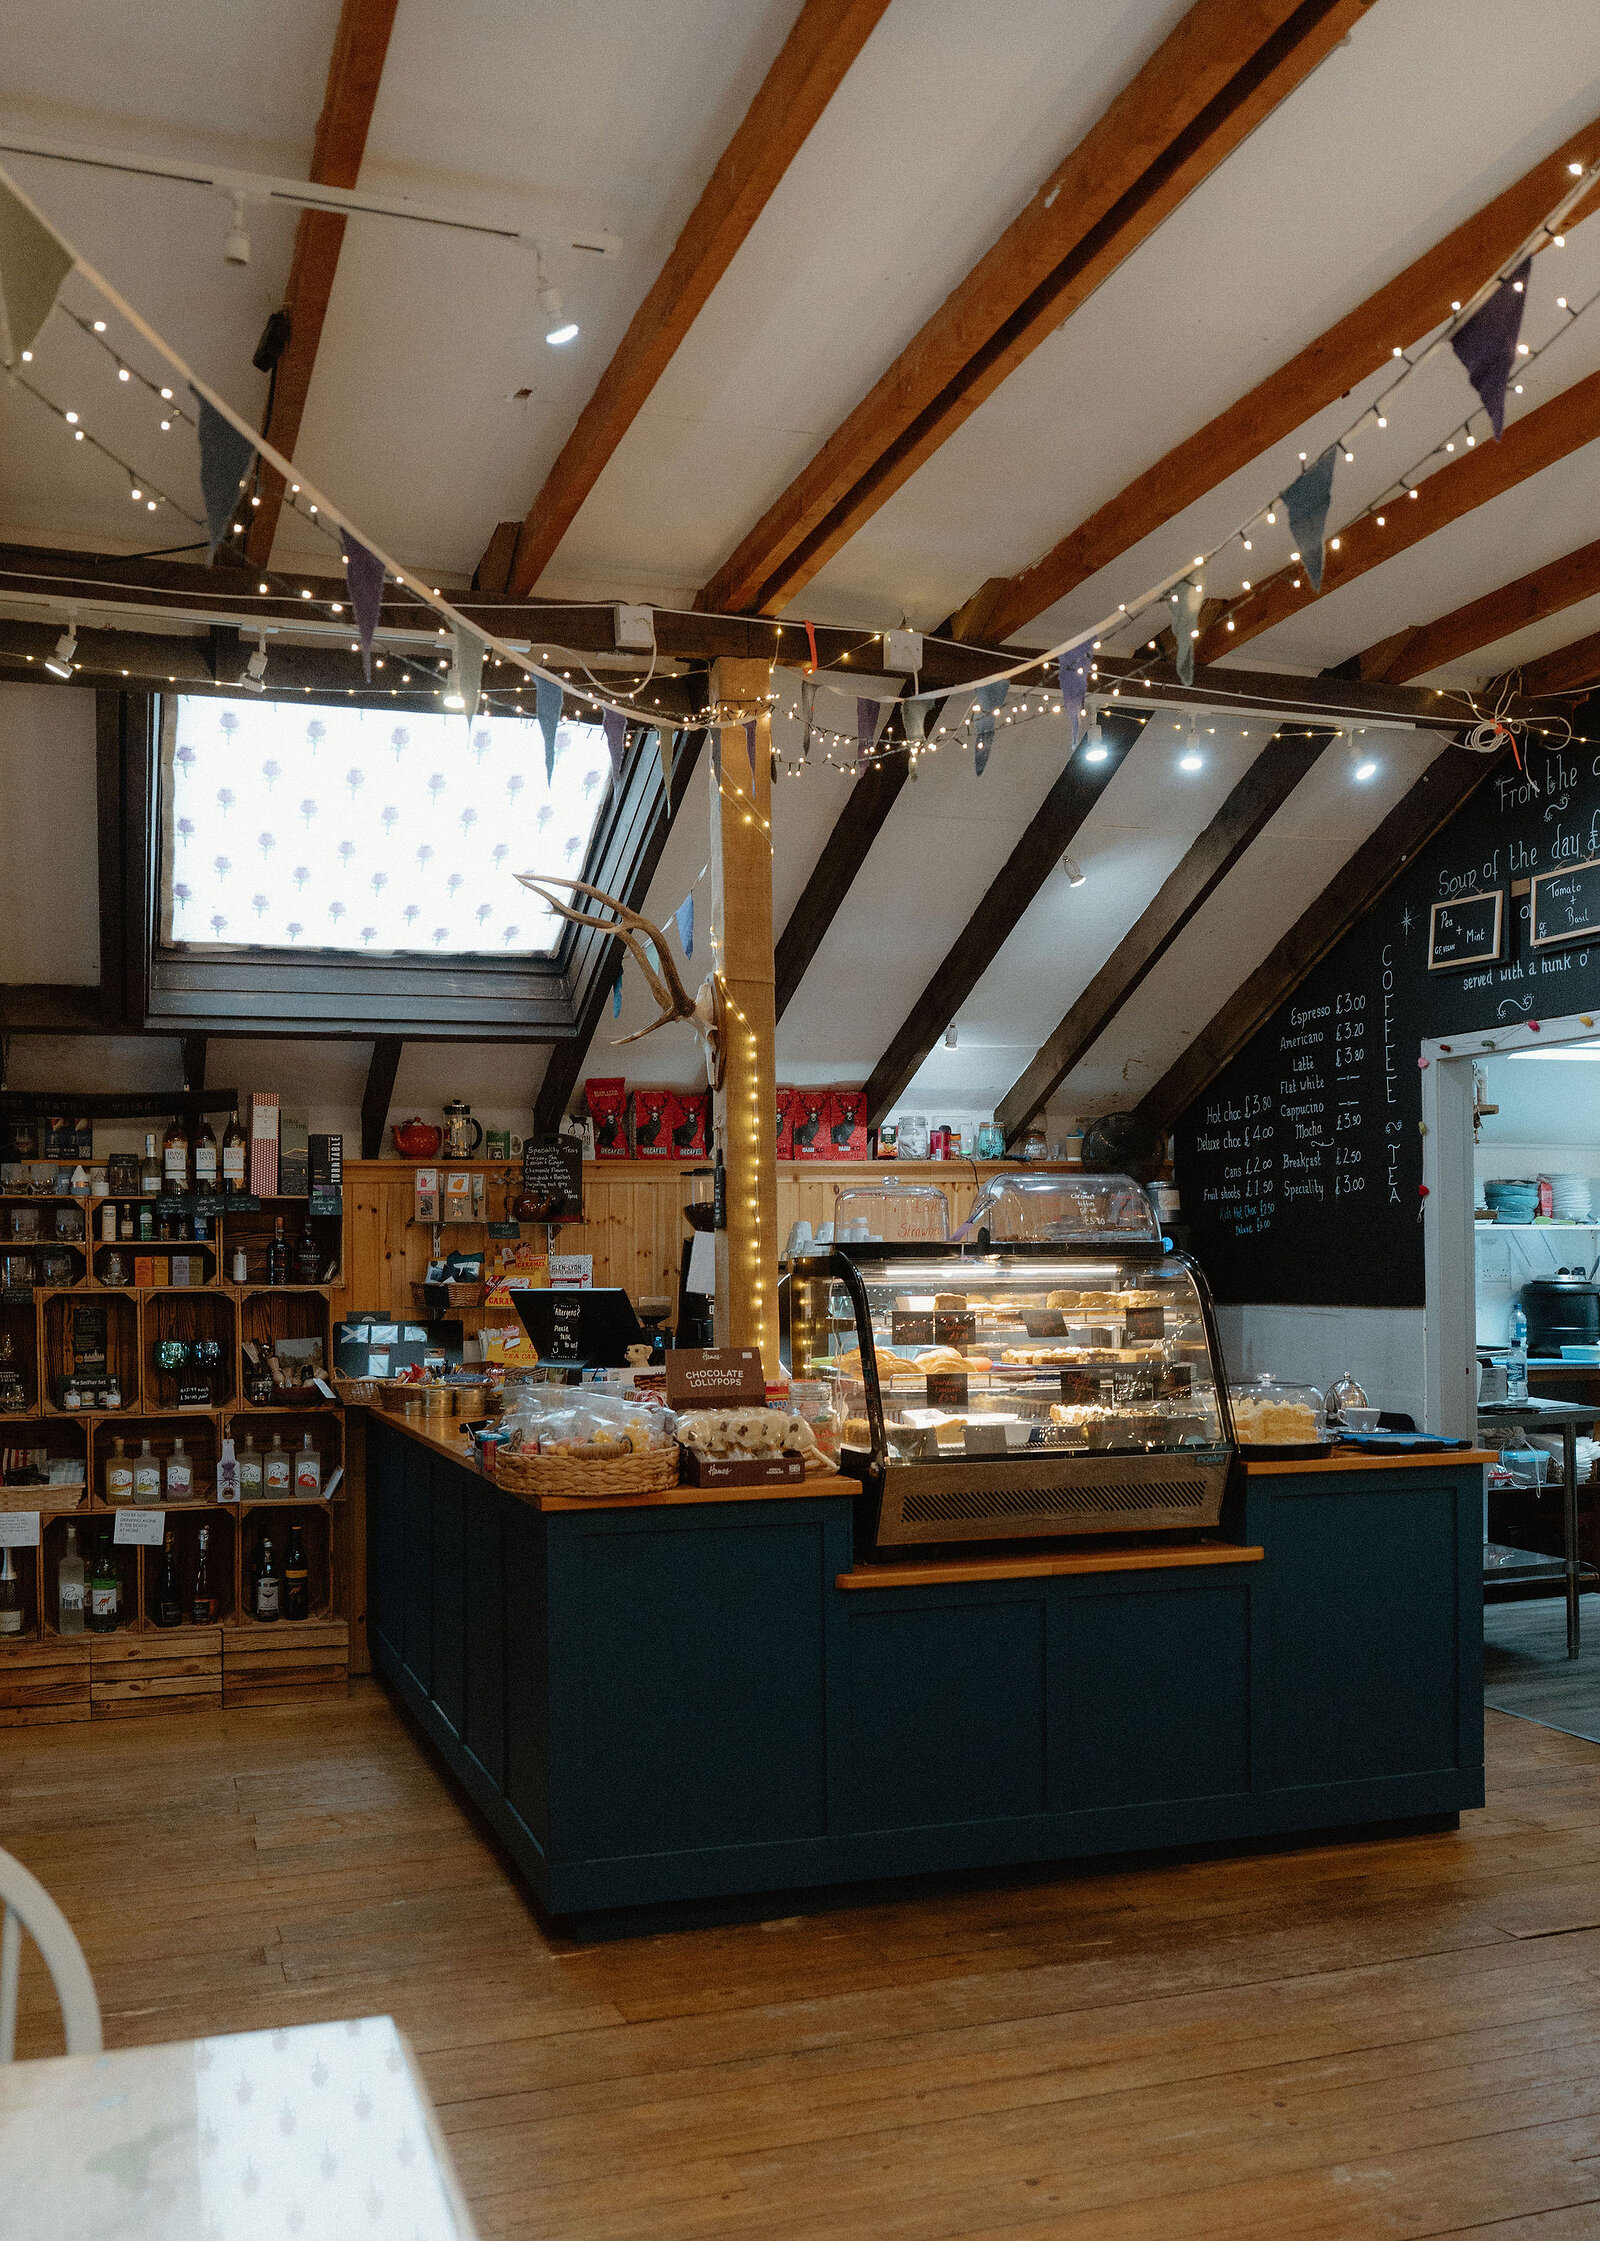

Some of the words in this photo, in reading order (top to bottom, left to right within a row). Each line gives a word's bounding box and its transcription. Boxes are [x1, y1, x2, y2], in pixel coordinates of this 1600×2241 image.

[1547, 754, 1578, 796] the
[1438, 869, 1477, 896] Soup
[1482, 849, 1499, 881] of
[1509, 840, 1538, 870] the
[1551, 824, 1581, 860] day
[1546, 877, 1582, 899] Tomato
[1441, 910, 1454, 929] Pea
[1565, 906, 1589, 927] Basil
[1466, 928, 1486, 944] Mint
[1463, 962, 1493, 990] served
[1500, 959, 1525, 982] with
[1529, 961, 1537, 976] a
[1541, 952, 1572, 975] hunk
[1290, 1005, 1331, 1030] Espresso
[1279, 1031, 1325, 1052] Americano
[1280, 1079, 1297, 1095] Flat
[1299, 1074, 1325, 1091] white
[1206, 1103, 1222, 1125] Hot
[1223, 1101, 1242, 1122] choc
[1280, 1098, 1325, 1121] Cappucino
[1223, 1130, 1242, 1149] choc
[1295, 1121, 1322, 1140] Mocha
[330, 1136, 342, 1184] TURNTABLE
[1282, 1150, 1322, 1174] Breakfast
[1224, 1166, 1242, 1179] Cans
[1220, 1184, 1241, 1200] shoots
[1284, 1179, 1324, 1202] Speciality
[517, 1261, 545, 1269] CARAMEL
[685, 1369, 744, 1380] CHOCOLATE
[690, 1377, 742, 1388] LOLLYPOPS
